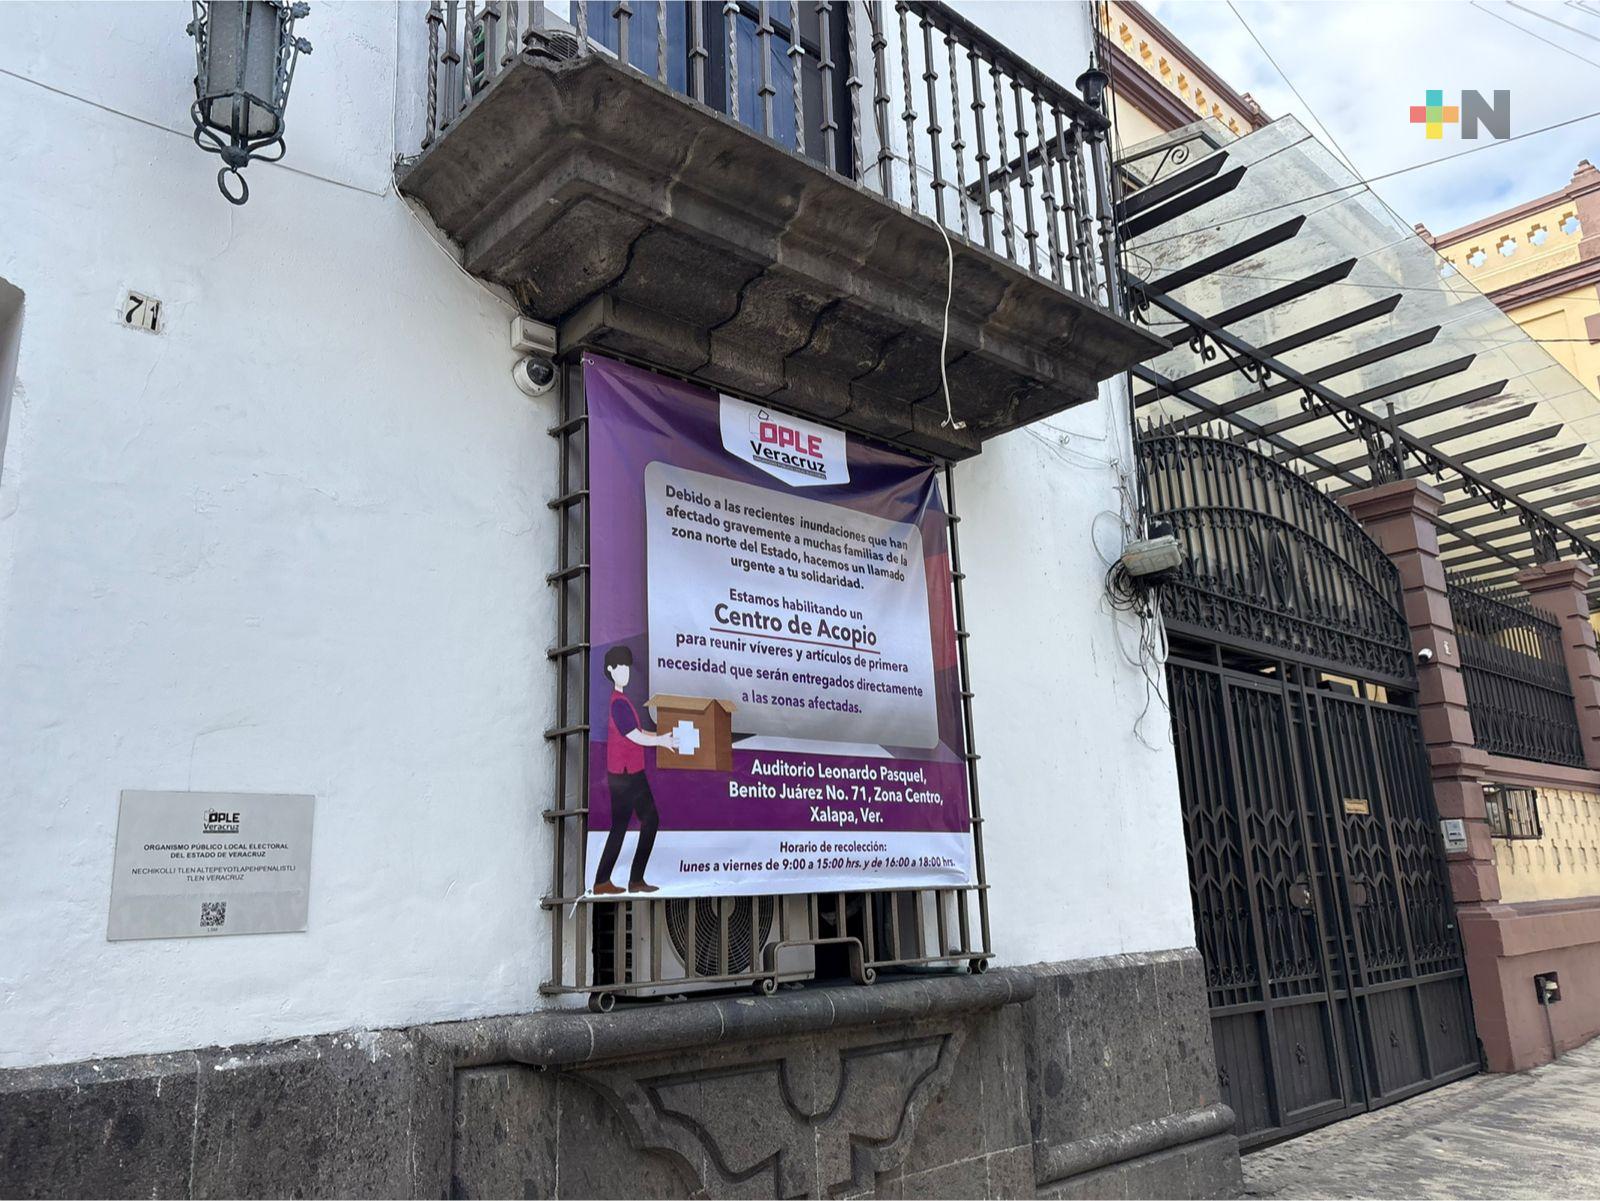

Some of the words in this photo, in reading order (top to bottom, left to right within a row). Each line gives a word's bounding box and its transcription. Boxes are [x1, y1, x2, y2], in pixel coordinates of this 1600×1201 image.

[126, 295, 159, 330] 71
[760, 422, 823, 458] OPLE
[750, 440, 827, 473] Veracruz
[666, 485, 711, 506] Debido
[714, 499, 721, 509] a
[725, 498, 741, 513] las
[744, 507, 795, 525] recientes
[800, 517, 865, 542] inundaciones
[868, 535, 887, 547] que
[889, 537, 908, 550] han
[666, 505, 720, 526] afectado
[723, 520, 791, 541] gravemente
[794, 535, 800, 544] a
[803, 537, 842, 553] muchas
[844, 544, 884, 561] familias
[886, 552, 898, 563] de
[901, 554, 908, 566] la
[672, 527, 702, 541] zona
[706, 533, 737, 548] norte
[740, 539, 758, 553] del
[761, 543, 801, 563] Estado,
[803, 552, 849, 571] hacemos
[852, 564, 865, 574] un
[868, 564, 905, 581] llamado
[731, 557, 775, 572] urgente
[778, 567, 785, 576] a
[787, 567, 799, 578] tu
[801, 569, 864, 589] solidaridad.
[729, 588, 780, 607] Estamos
[782, 597, 847, 617] habilitando
[850, 610, 863, 620] un
[714, 603, 782, 632] Centro
[787, 614, 812, 636] de
[817, 619, 877, 649] Acopio
[676, 633, 707, 647] para
[710, 637, 747, 652] reunir
[749, 641, 793, 658] víveres
[796, 649, 803, 662] y
[806, 649, 852, 665] artículos
[854, 655, 867, 667] de
[869, 658, 909, 673] primera
[657, 657, 727, 674] necesidad
[730, 665, 753, 679] que
[756, 668, 789, 682] serán
[792, 672, 855, 689] entregados
[856, 678, 923, 697] directamente
[742, 692, 749, 702] a
[752, 690, 768, 704] las
[771, 696, 805, 708] zonas
[808, 696, 862, 713] afectadas.
[751, 758, 815, 778] Auditorio
[818, 763, 877, 780] Leonardo
[880, 765, 927, 786] Pasquel,
[729, 780, 777, 799] Benito
[779, 783, 823, 800] Juárez
[825, 784, 849, 801] No.
[851, 785, 872, 804] 71,
[873, 786, 903, 803] Zona
[905, 788, 944, 806] Centro,
[203, 823, 240, 831] Veracruz
[207, 812, 241, 823] OPLE
[810, 805, 859, 827] Xalapa,
[860, 807, 884, 823] Ver.
[780, 841, 818, 853] Horario
[820, 841, 832, 852] de
[834, 840, 887, 852] recolección:
[679, 860, 710, 873] lunes
[713, 863, 720, 872] a
[723, 859, 763, 872] viernes
[765, 858, 780, 871] de
[782, 858, 806, 870] 9:00
[808, 861, 814, 870] a
[817, 857, 844, 869] 15:00
[845, 857, 862, 869] hrs.
[863, 860, 869, 870] y
[871, 857, 882, 868] de
[885, 857, 910, 868] 16:00
[911, 860, 917, 868] a
[919, 856, 941, 868] 18:00
[942, 856, 956, 868] hrs.
